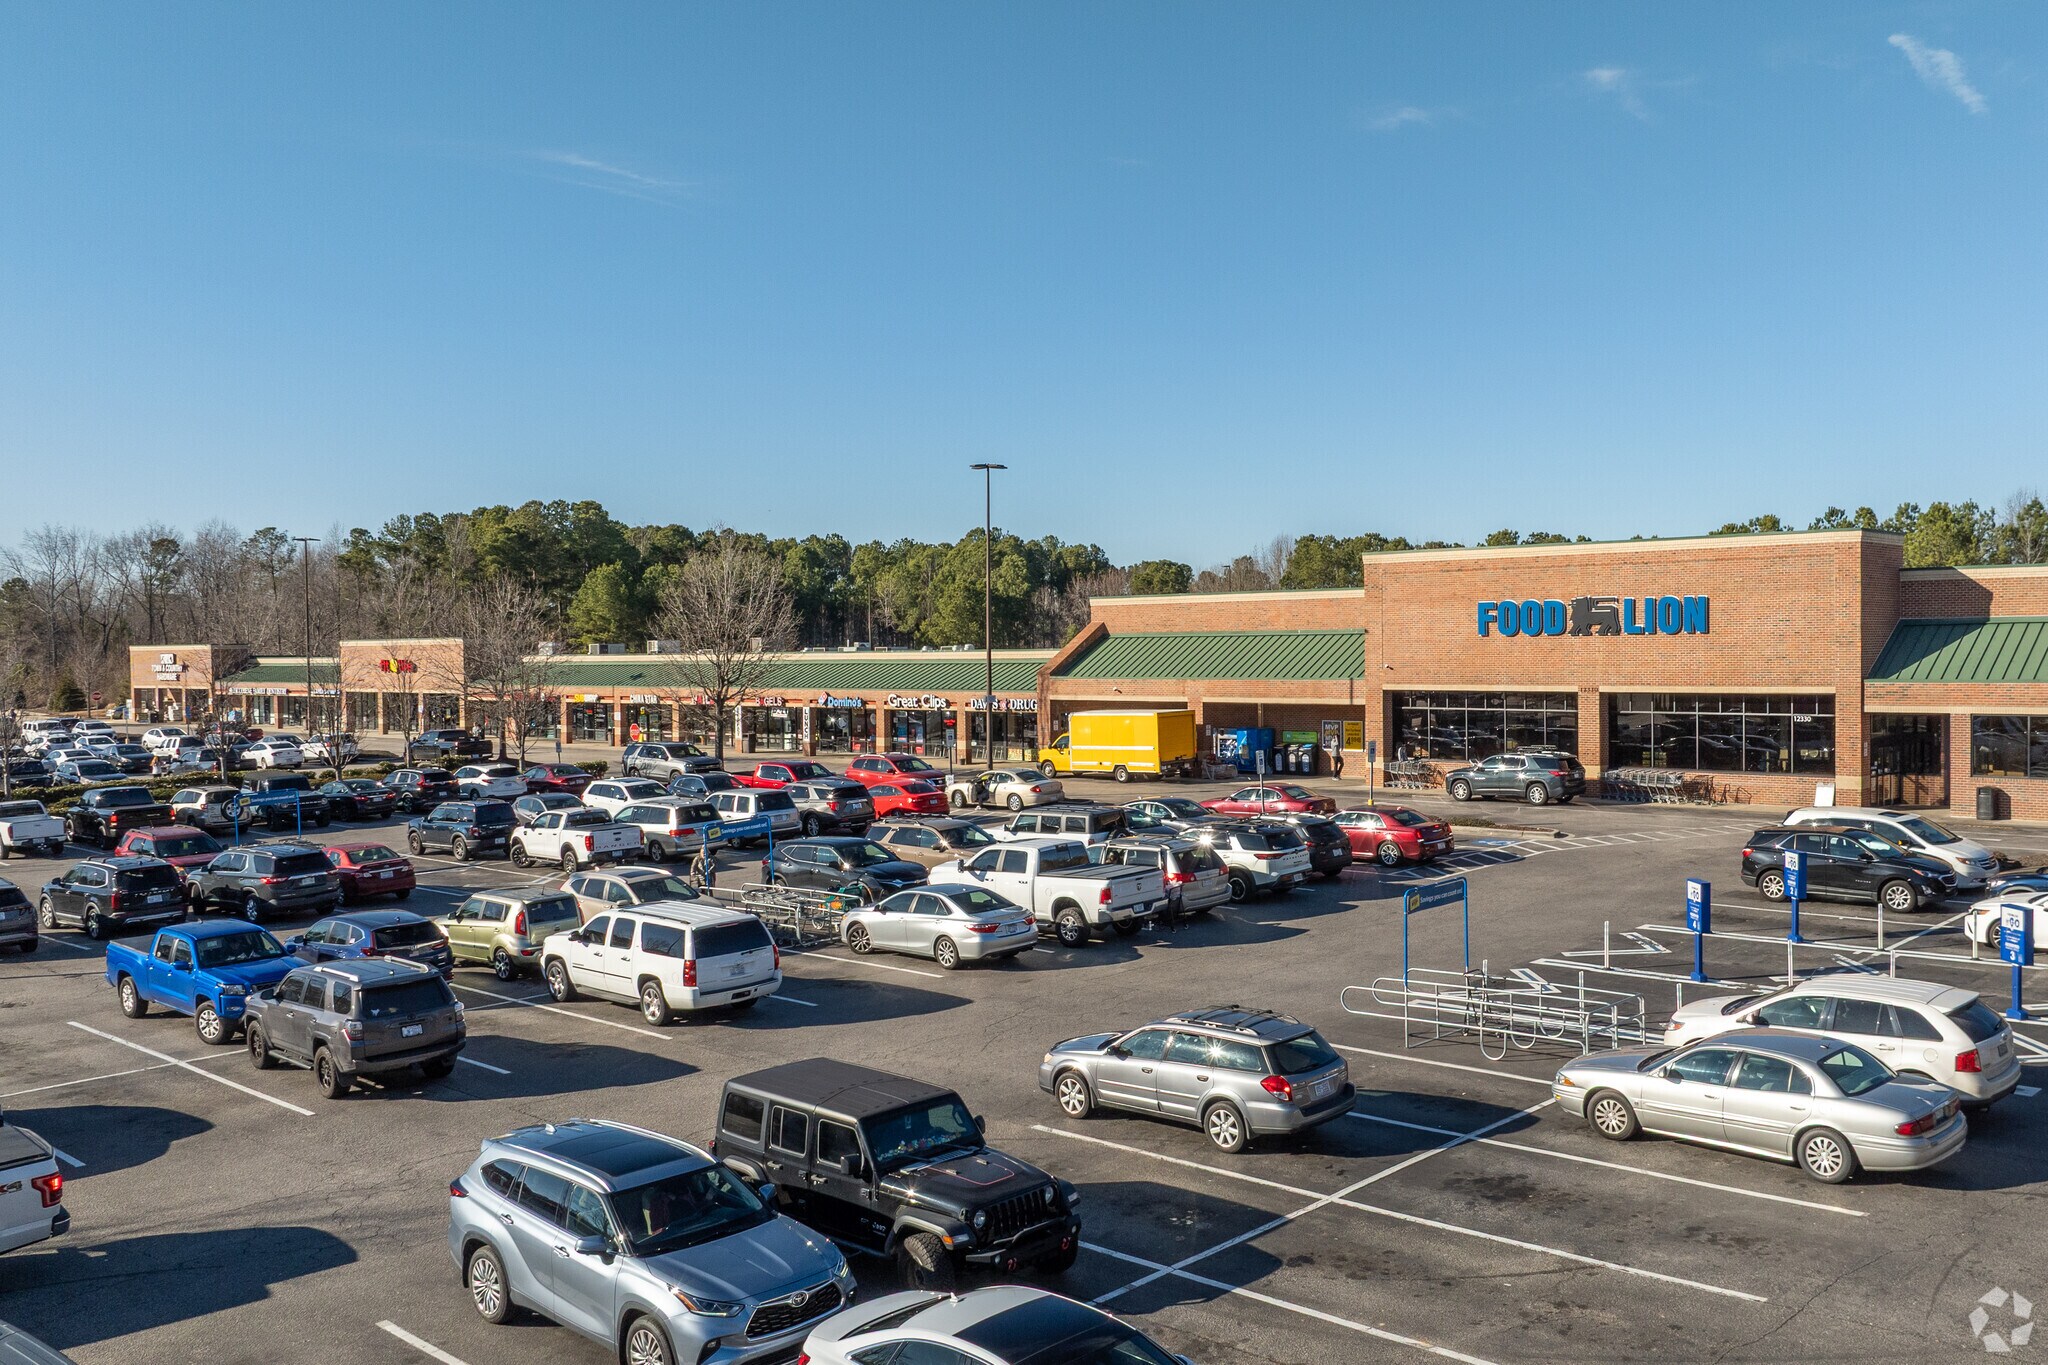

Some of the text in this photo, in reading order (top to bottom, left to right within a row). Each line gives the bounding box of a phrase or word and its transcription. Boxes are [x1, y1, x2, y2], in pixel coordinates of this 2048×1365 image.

[1478, 595, 1710, 637] FOOD LION
[828, 697, 862, 707] Domino's
[888, 693, 947, 712] Great Clips
[971, 698, 1038, 710] DAVS DRUG
[2010, 950, 2016, 961] 3
